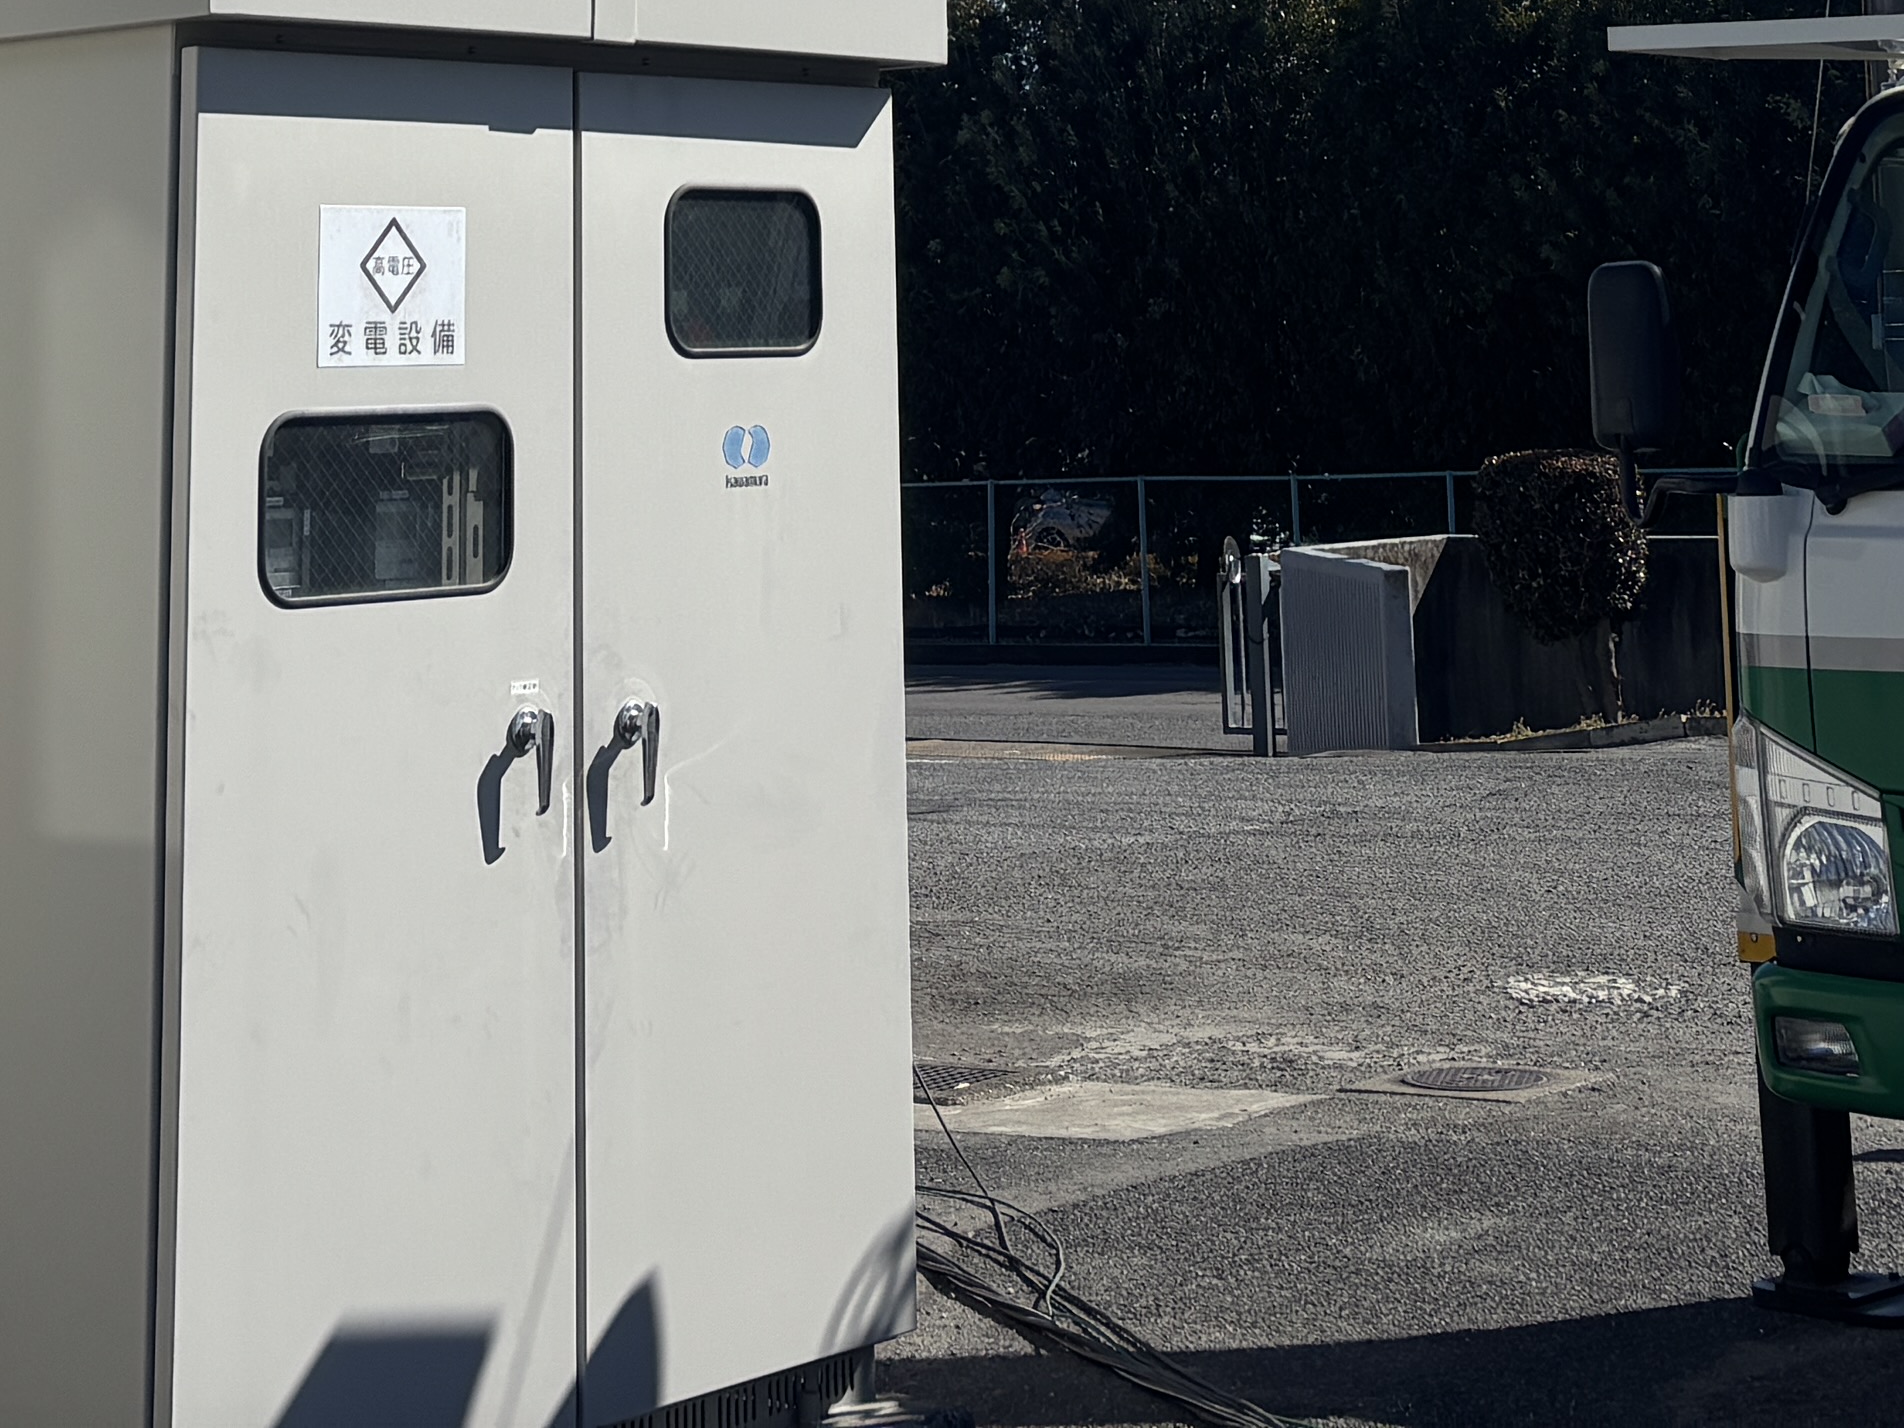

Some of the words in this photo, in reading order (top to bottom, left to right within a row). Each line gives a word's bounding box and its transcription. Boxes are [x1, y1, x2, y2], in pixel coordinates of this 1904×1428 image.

[372, 255, 415, 276] 高電圧
[329, 319, 456, 357] 変電設備
